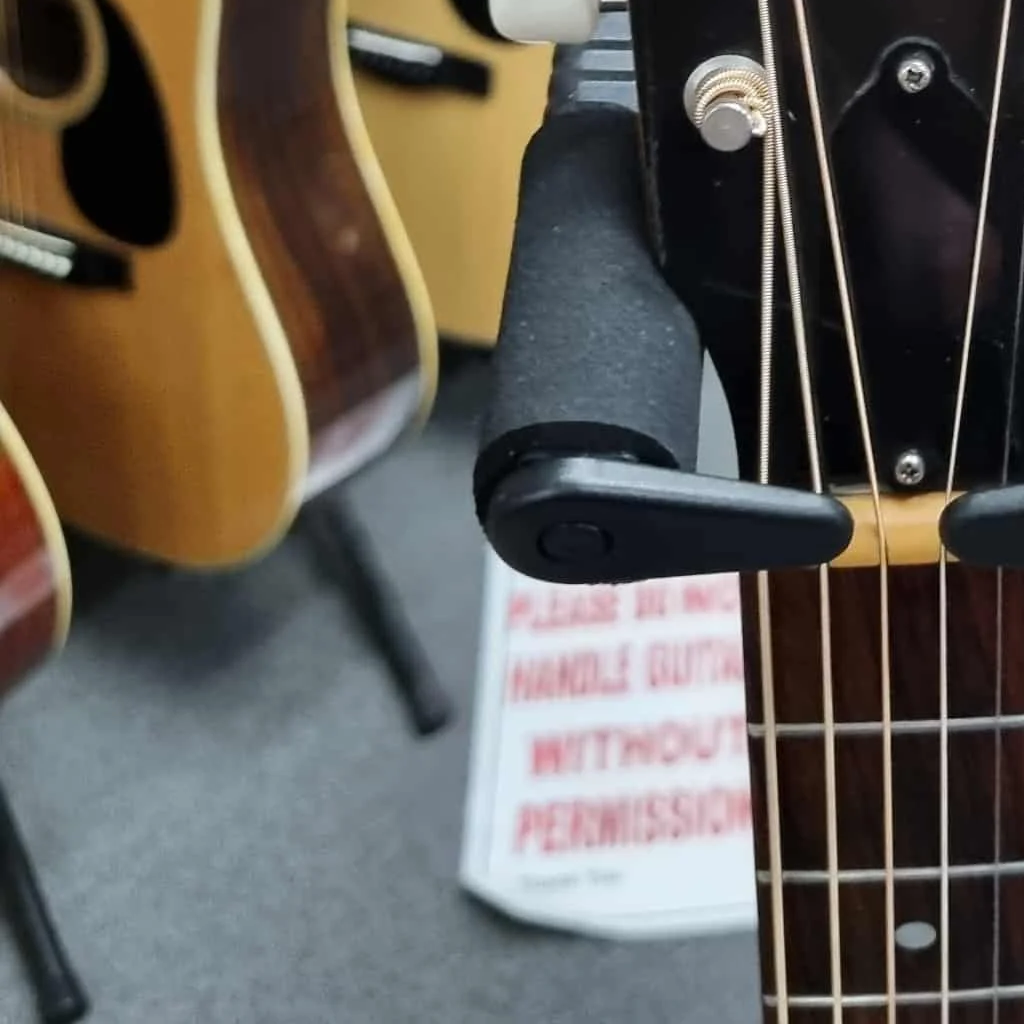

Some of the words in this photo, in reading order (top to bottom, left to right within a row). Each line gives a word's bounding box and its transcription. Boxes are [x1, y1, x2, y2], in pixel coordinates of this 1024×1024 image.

[511, 645, 629, 701] HANDLE
[648, 638, 743, 688] GUITA
[532, 717, 748, 774] WITHOUT
[514, 788, 751, 851] PERMISSION
